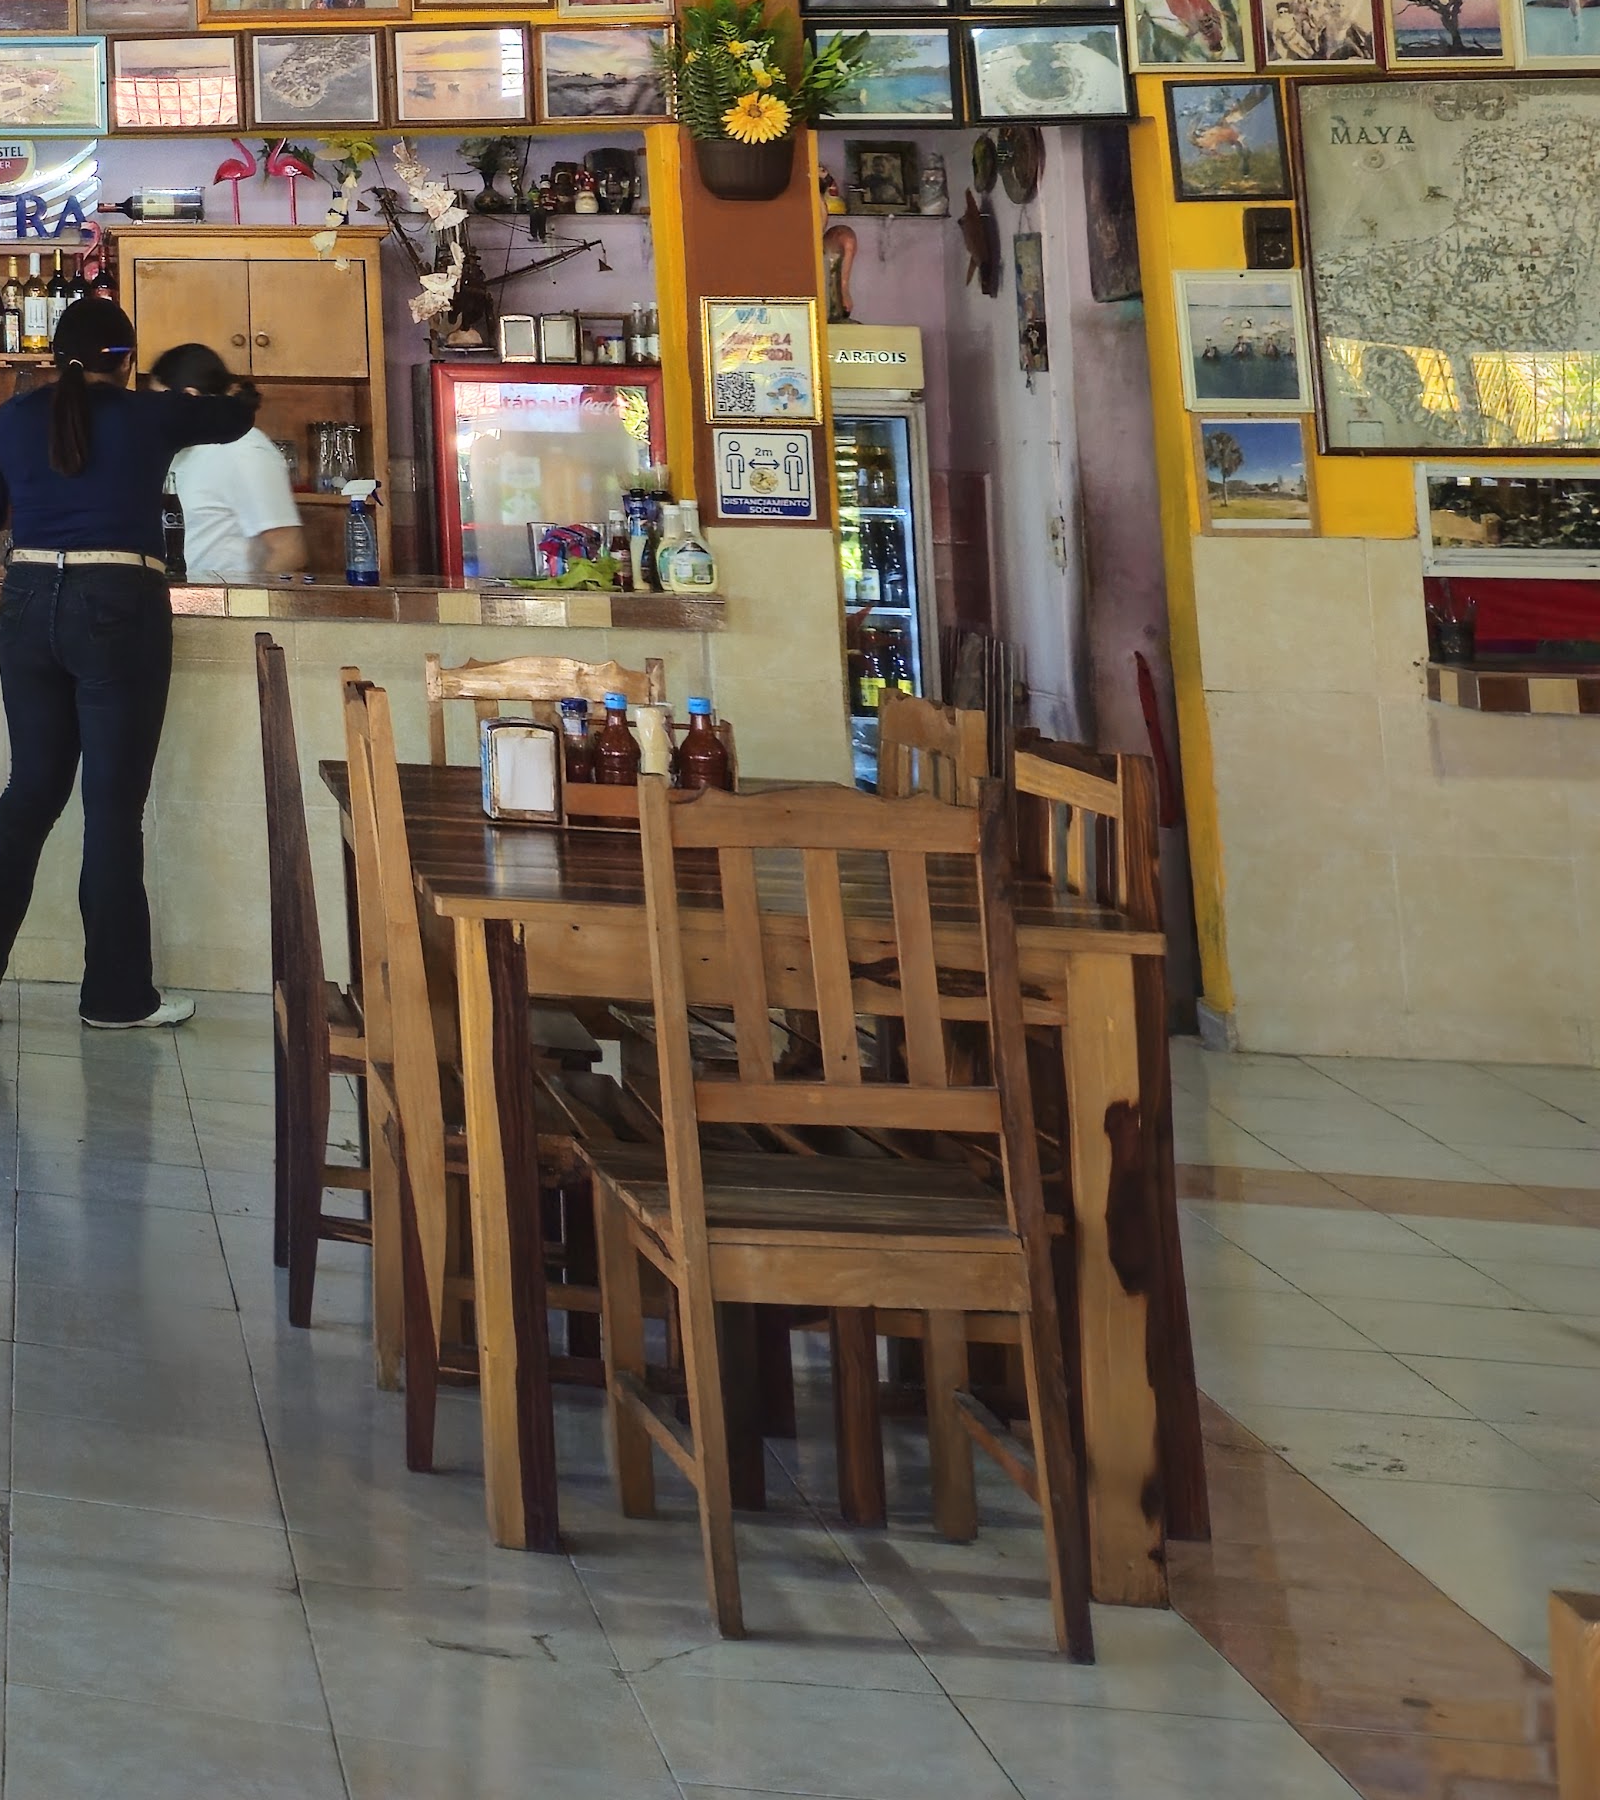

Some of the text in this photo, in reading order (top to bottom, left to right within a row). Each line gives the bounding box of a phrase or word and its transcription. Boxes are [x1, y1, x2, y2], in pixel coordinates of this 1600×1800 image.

[1330, 126, 1415, 145] MAYA
[837, 350, 907, 363] ARTOIS
[754, 447, 773, 457] 2m
[722, 498, 810, 508] DISTANCIAMIENTO
[749, 506, 784, 515] SOCIAL
